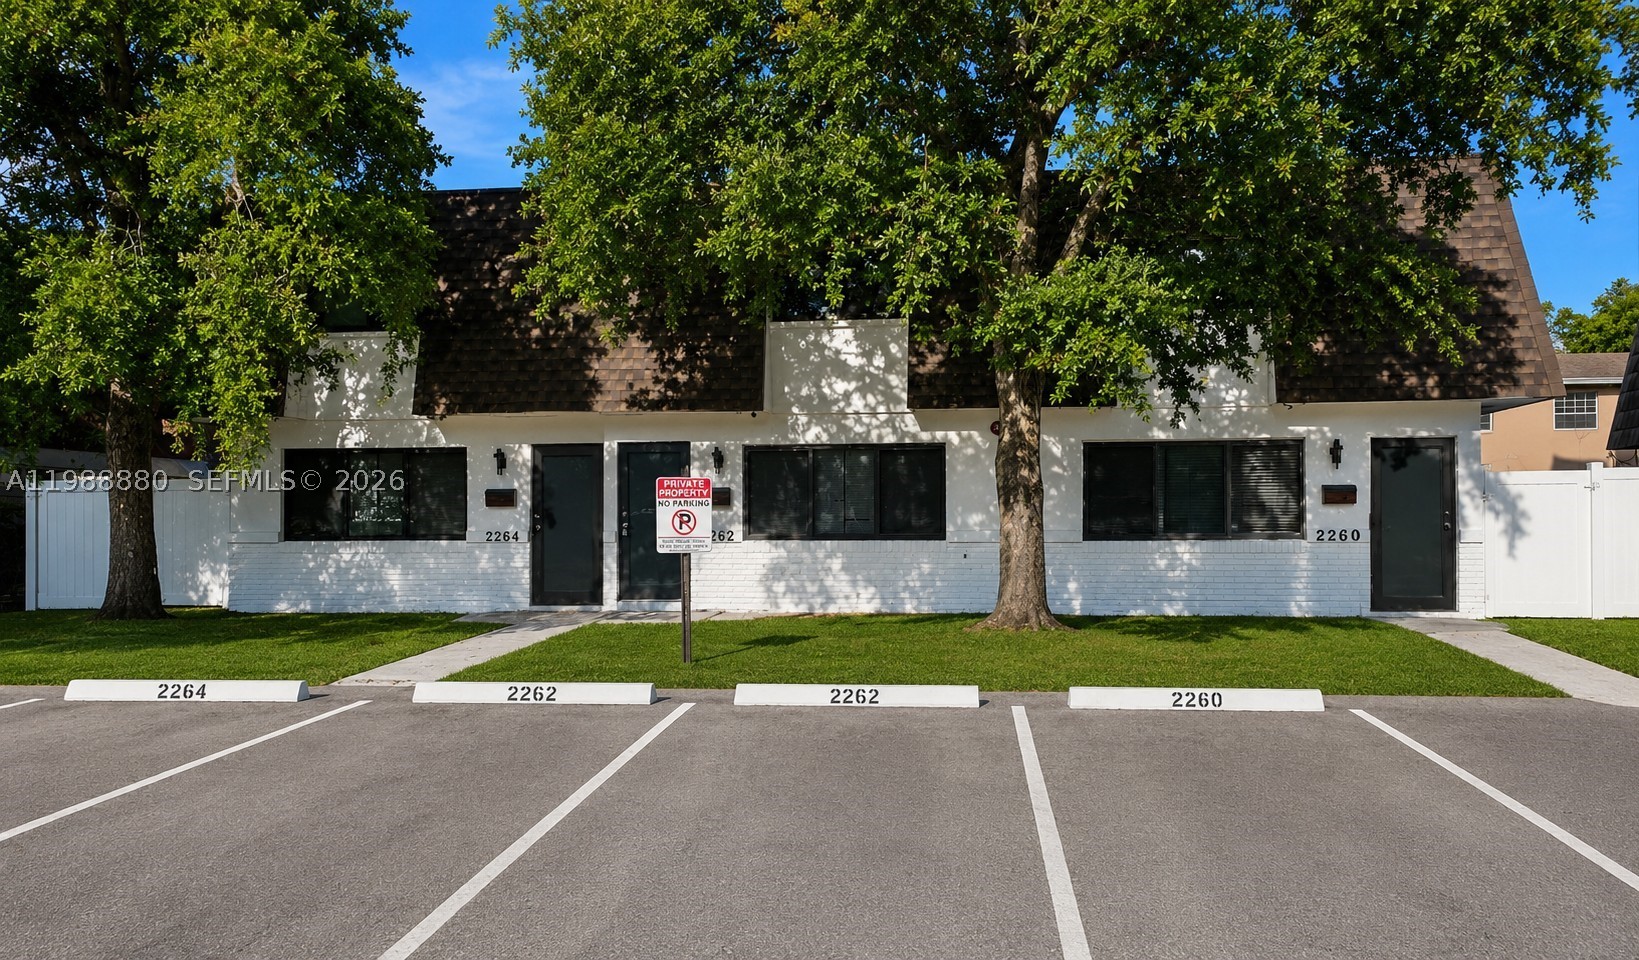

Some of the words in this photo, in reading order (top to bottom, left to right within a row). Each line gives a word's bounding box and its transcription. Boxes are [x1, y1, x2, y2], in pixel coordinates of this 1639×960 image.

[663, 479, 705, 488] PRIVATE
[659, 489, 709, 497] PROPERTY
[485, 530, 519, 542] 2264
[711, 530, 734, 542] 262
[1316, 529, 1361, 542] 2260
[157, 683, 206, 699] 2264
[507, 686, 557, 701] 2262
[830, 688, 879, 704] 2262
[1171, 692, 1223, 708] 2260
